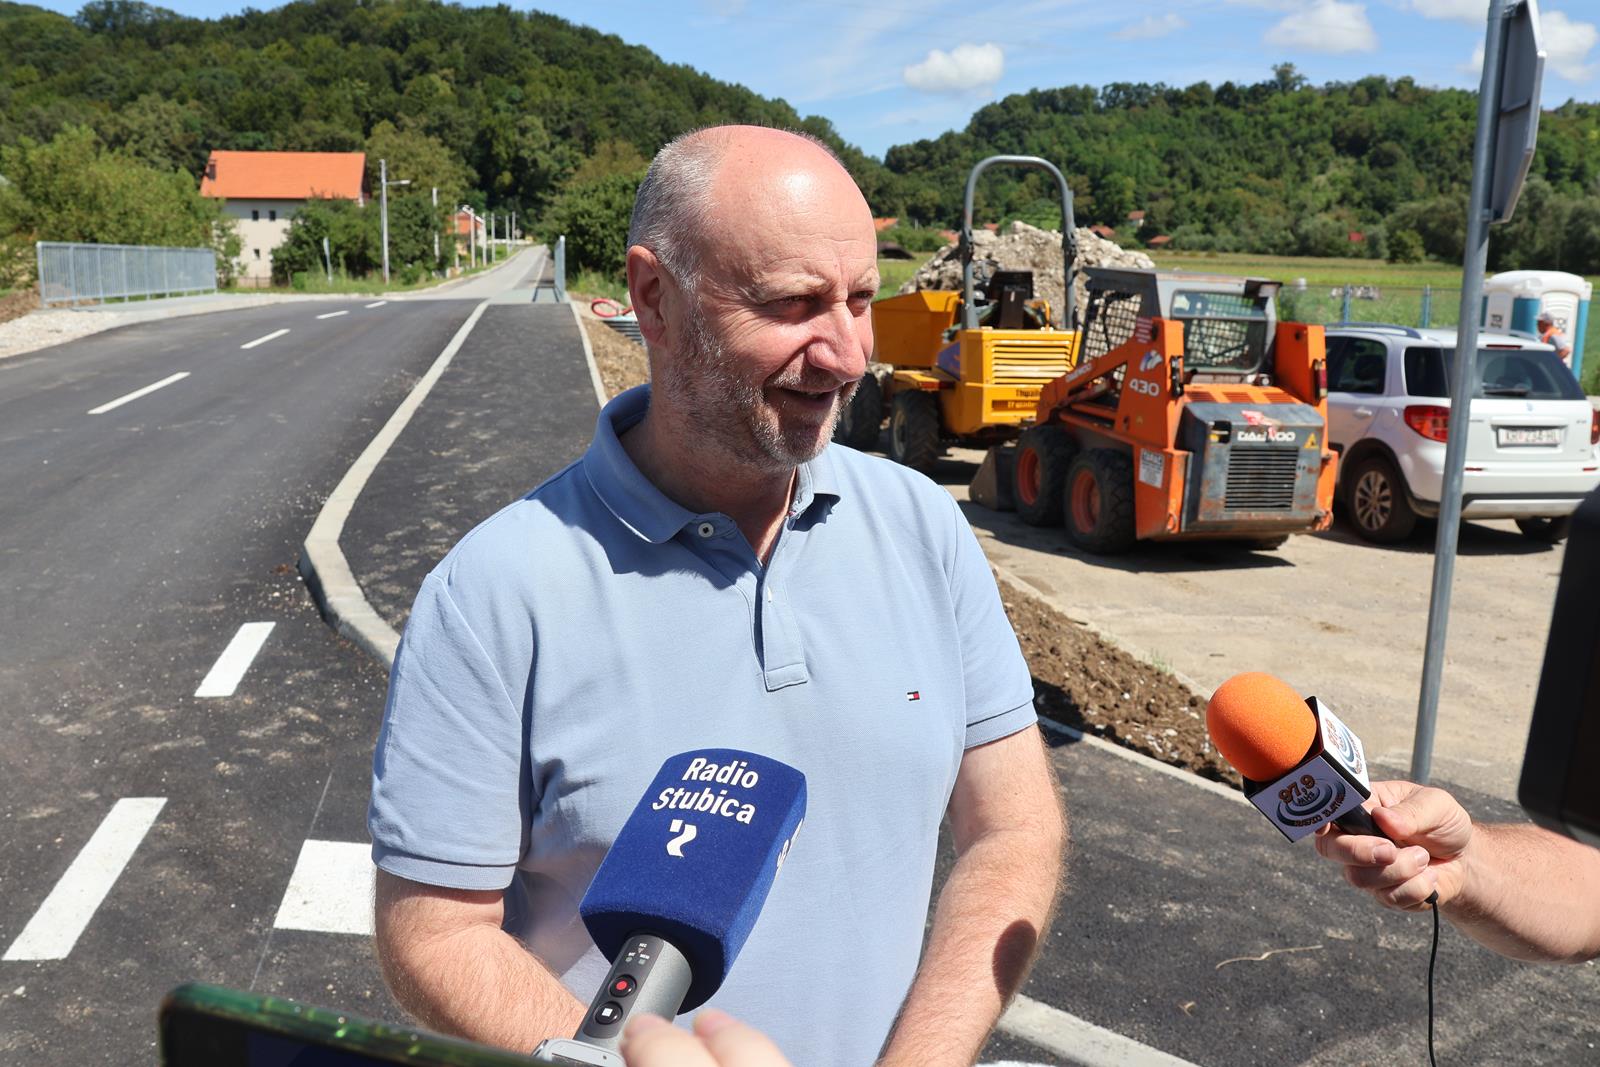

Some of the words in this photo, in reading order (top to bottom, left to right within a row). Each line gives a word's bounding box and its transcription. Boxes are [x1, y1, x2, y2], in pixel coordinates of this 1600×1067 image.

[1129, 378, 1160, 396] 430
[1237, 431, 1296, 441] DAOO
[681, 758, 759, 788] Radio
